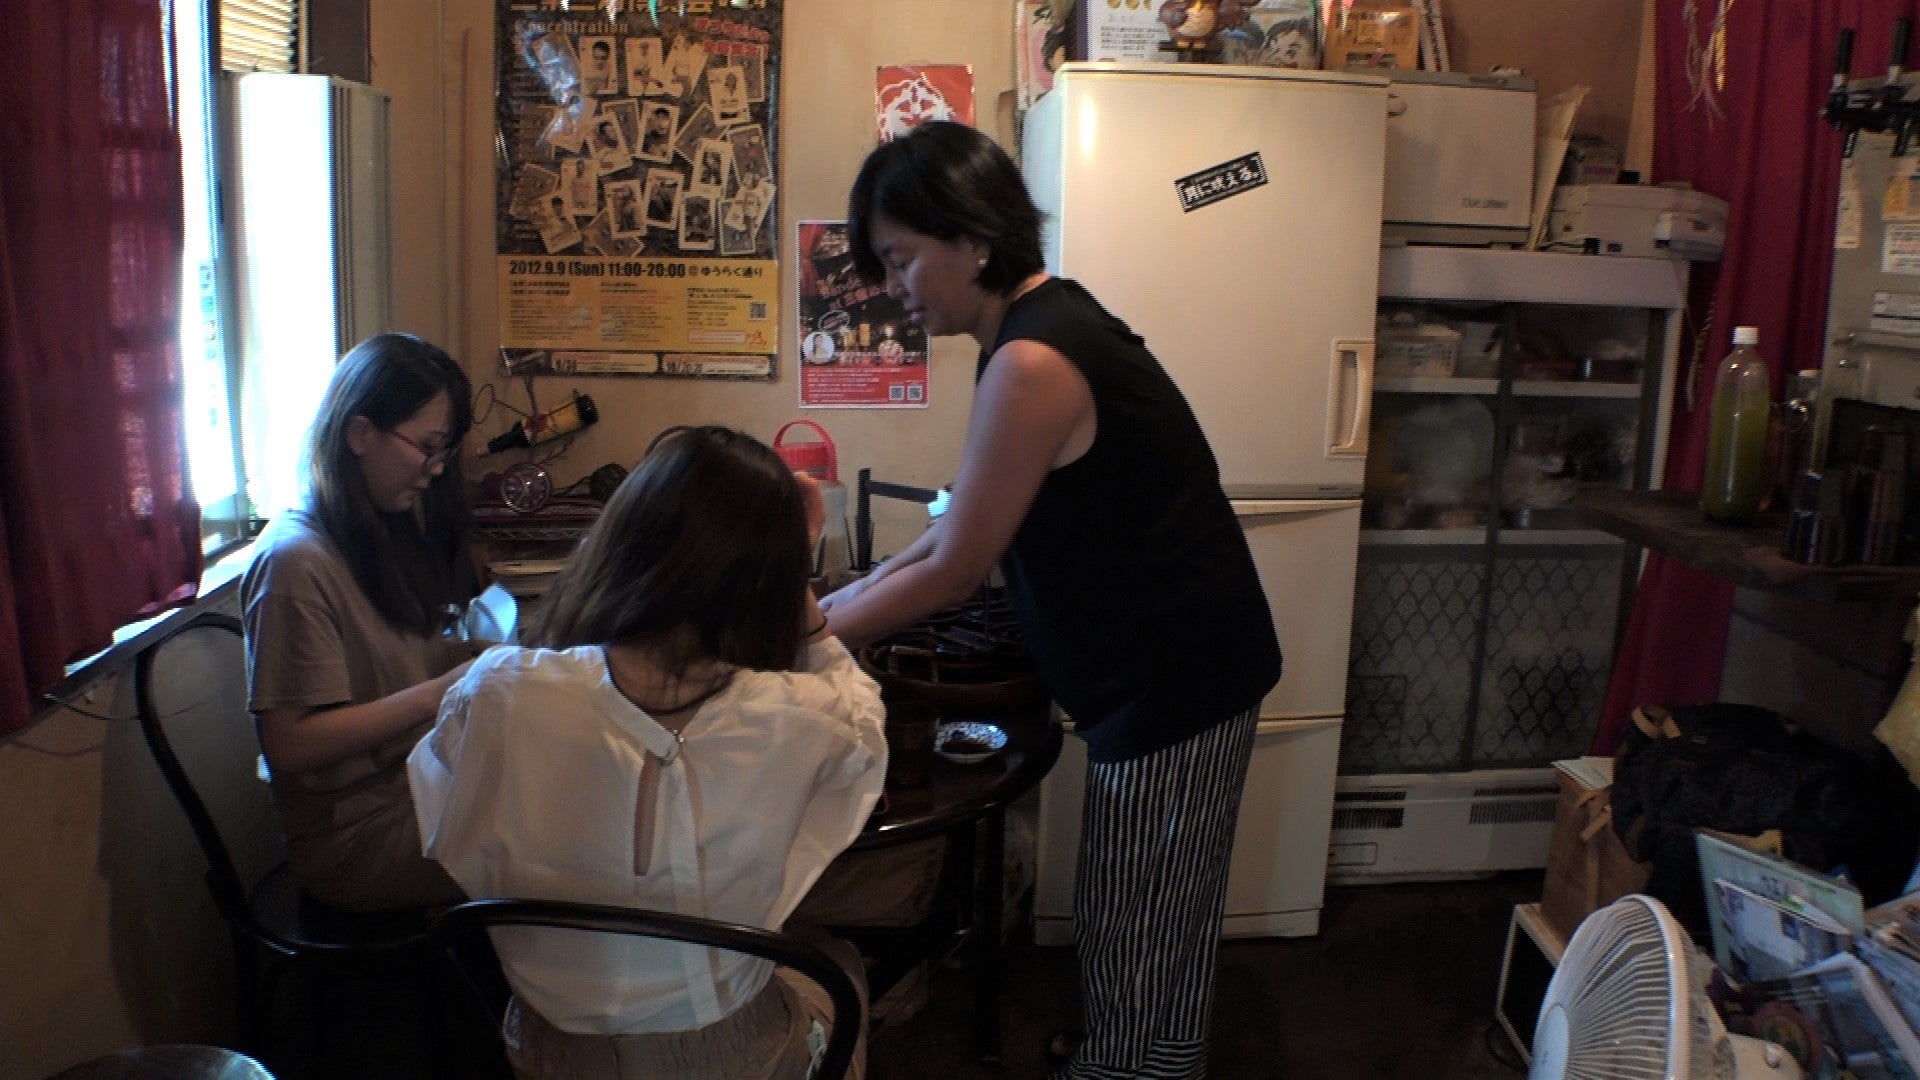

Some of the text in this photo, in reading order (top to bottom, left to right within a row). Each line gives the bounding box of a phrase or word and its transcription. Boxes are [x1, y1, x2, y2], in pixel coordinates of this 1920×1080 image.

[509, 260, 565, 276] 2012.9.9
[568, 261, 605, 277] (Sun)
[609, 262, 686, 278] 11:00-20:00
